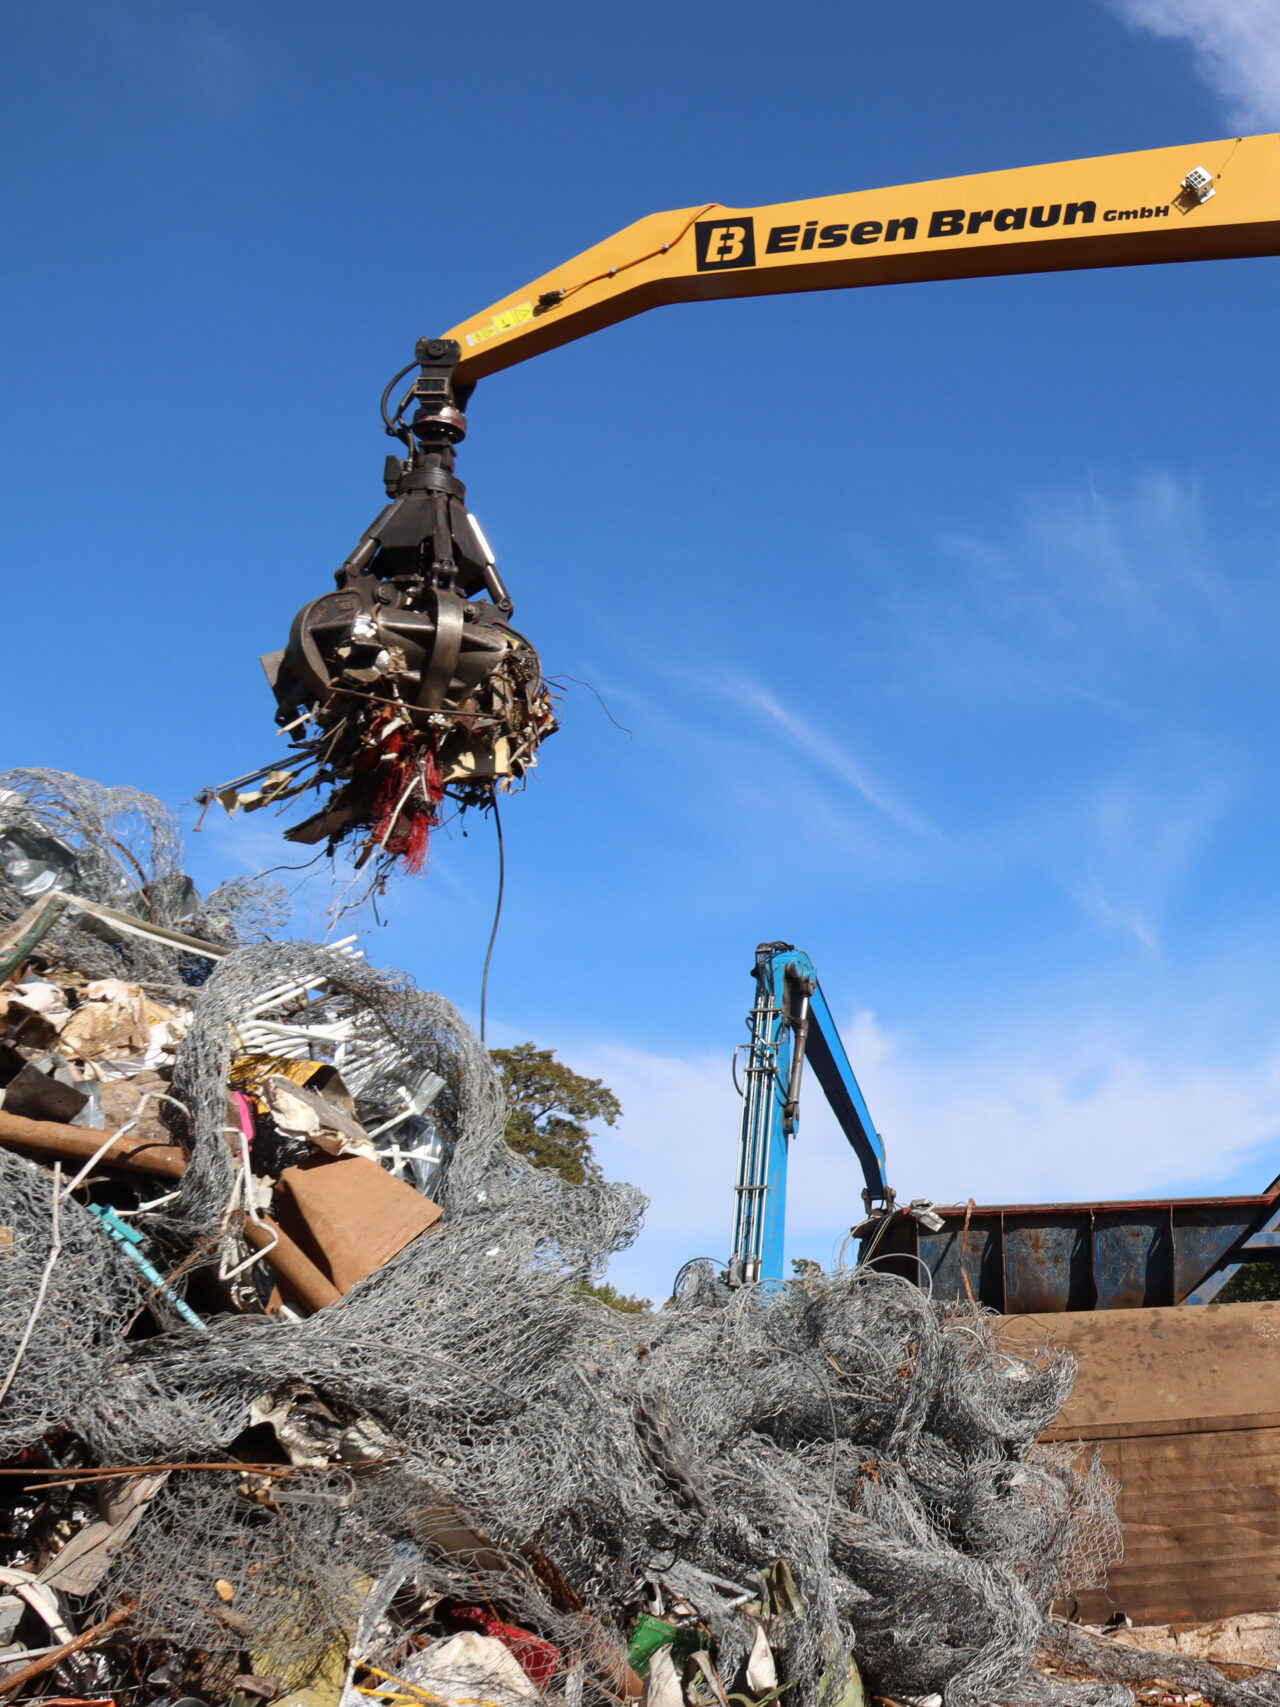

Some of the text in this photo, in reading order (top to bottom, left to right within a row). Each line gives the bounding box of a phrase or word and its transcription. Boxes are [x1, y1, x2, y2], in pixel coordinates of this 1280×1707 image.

[765, 217, 918, 254] Eisen
[927, 200, 1096, 238] Braun
[1103, 205, 1170, 222] GmbH
